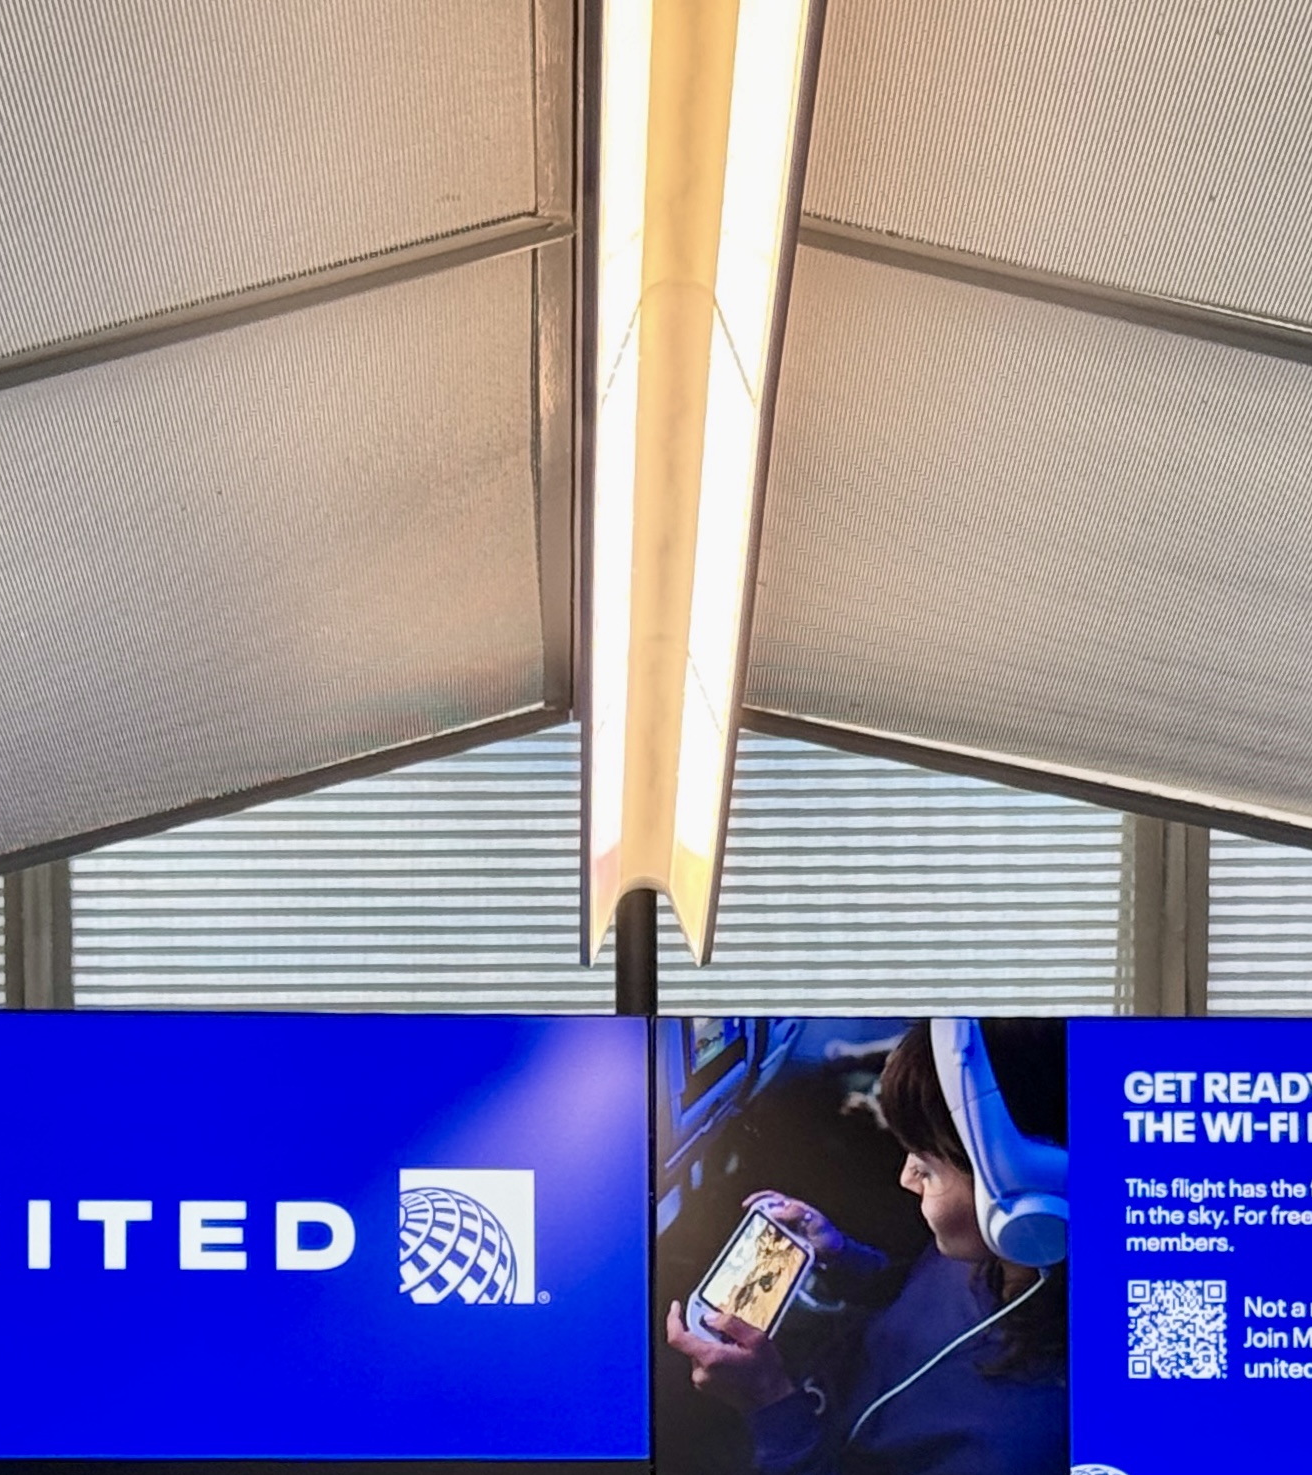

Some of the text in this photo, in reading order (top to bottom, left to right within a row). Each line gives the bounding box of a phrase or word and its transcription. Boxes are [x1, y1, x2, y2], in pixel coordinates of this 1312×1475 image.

[1123, 1071, 1197, 1104] GET
[1123, 1111, 1196, 1143] THE
[1201, 1111, 1299, 1143] WI-FI
[1124, 1177, 1169, 1199] This
[1171, 1177, 1226, 1204] flight
[1228, 1178, 1268, 1199] has
[1270, 1178, 1307, 1199] the
[1125, 1205, 1145, 1225] in
[1147, 1205, 1185, 1225] the
[1187, 1204, 1230, 1229] sky.
[1233, 1205, 1268, 1226] For
[1126, 1232, 1234, 1252] members.
[1244, 1296, 1288, 1318] Not
[1290, 1301, 1306, 1318] a
[1243, 1326, 1289, 1349] Join
